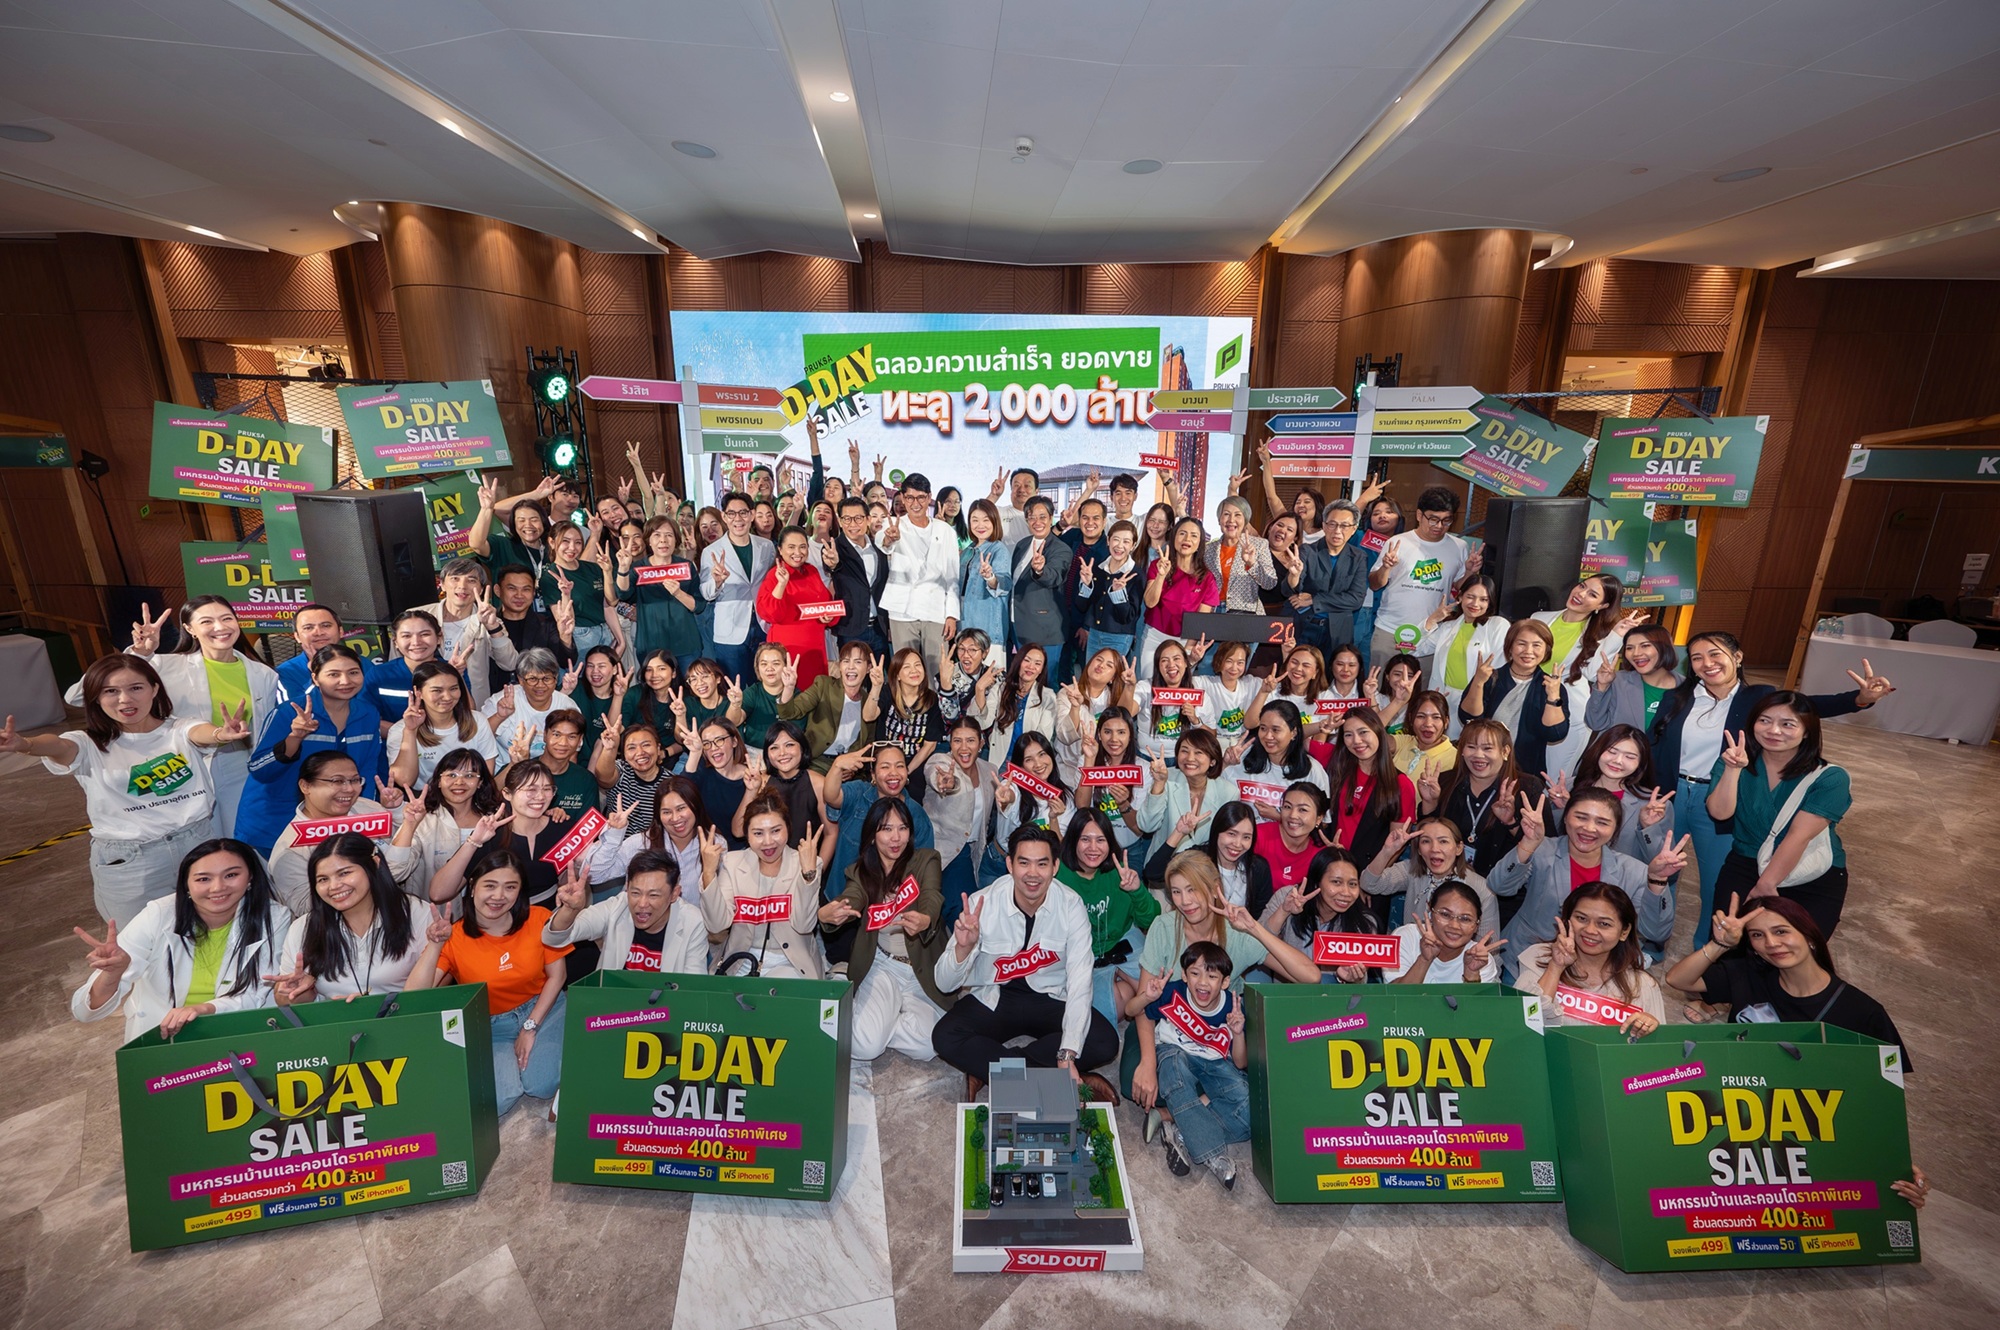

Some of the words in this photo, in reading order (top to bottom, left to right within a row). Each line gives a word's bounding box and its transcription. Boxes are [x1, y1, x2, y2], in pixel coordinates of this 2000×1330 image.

[804, 354, 833, 375] PRUKSA
[876, 345, 1053, 375] ฉลองความสำเร็จ
[1062, 349, 1152, 369] ยอดขาย
[621, 384, 649, 396] รังสิต
[780, 342, 877, 427] D-DAY
[716, 391, 750, 401] พระราม
[753, 392, 759, 401] 2
[1182, 397, 1208, 405] บางนา
[1267, 393, 1320, 406] ประชาอุทิศ
[379, 400, 470, 429] D-DAY
[816, 390, 872, 440] SALE
[882, 387, 953, 434] ทะลุ
[963, 382, 1080, 431] 2,000
[716, 416, 763, 425] เพชรเกษม
[1180, 417, 1204, 429] ชลบุรี
[1285, 420, 1341, 428] บางนา-วงแหวน
[1379, 418, 1413, 426] รามคำแหง
[1415, 417, 1461, 428] กรุงเทพกรีฑา
[237, 430, 265, 439] PRUKSA
[405, 426, 459, 444] SALE
[724, 435, 759, 448] ปิ่นเกล้า
[1481, 419, 1563, 465] D-DAY
[197, 429, 304, 466] D-DAY
[380, 440, 484, 455] มหกรรมบ้านและคอนโดราคาพิเศษ
[1277, 442, 1315, 451] รามอินทรา
[1317, 441, 1344, 451] วัชรพล
[1630, 436, 1732, 459] D-DAY
[434, 449, 453, 459] 400
[1144, 456, 1162, 464] SOLD
[1163, 459, 1177, 467] OUT
[1486, 444, 1533, 473] SALE
[218, 457, 281, 480] SALE
[736, 460, 751, 468] OUT
[1280, 462, 1336, 474] ภูเก็ต-ขอนแก่น
[1645, 460, 1702, 475] SALE
[179, 470, 306, 491] มหกรรมบ้านและคอนโดราคาพิเศษ
[1492, 470, 1509, 483] 400
[1613, 475, 1726, 483] มหกรรมบ้านและคอนโดราคาพิเศษ
[1664, 483, 1686, 491] 400
[643, 569, 666, 579] SOLD
[667, 567, 686, 576] OUT
[1415, 562, 1444, 577] D-DAY
[1422, 571, 1440, 581] SALE
[248, 587, 307, 604] SALE
[805, 605, 824, 615] SOLD
[824, 604, 842, 613] OUT
[1158, 692, 1181, 700] SOLD
[1182, 692, 1200, 701] OUT
[1321, 702, 1345, 710] SOLD
[133, 752, 189, 790] D-DAY
[154, 767, 190, 789] SALE
[1088, 771, 1115, 780] SOLD
[1116, 770, 1138, 779] OUT
[1012, 769, 1035, 787] SOLD
[1035, 784, 1056, 799] OUT
[1242, 786, 1269, 797] SOLD
[305, 825, 349, 839] SOLD
[352, 819, 385, 833] OUT
[554, 836, 582, 862] SOLD
[580, 814, 600, 837] OUT
[740, 904, 766, 917] SOLD
[873, 906, 895, 922] SOL
[1327, 941, 1365, 954] SOLD
[1365, 943, 1393, 956] OUT
[645, 956, 661, 970] OU
[1002, 958, 1030, 975] SOLD
[1030, 950, 1051, 965] OUT
[1556, 991, 1598, 1013] SOLD
[590, 1011, 666, 1029] ครั้งแรกและครั้งเดียว
[683, 1021, 724, 1033] PRUKSA
[1173, 1004, 1205, 1037] SOLD
[1203, 1032, 1228, 1047] OUT
[1291, 1019, 1365, 1039] ครั้งแรกและครั้งเดียว
[1383, 1027, 1425, 1037] PRUKSA
[277, 1056, 329, 1071] PRUKSA
[623, 1031, 788, 1087] D-DAY
[1328, 1038, 1493, 1090] D-DAY
[1627, 1066, 1702, 1090] ครั้งแรกและครั้งเดียว
[1722, 1076, 1767, 1087] PRUKSA
[203, 1057, 409, 1133] D-DAY
[651, 1084, 747, 1123] SALE
[1364, 1092, 1463, 1128] SALE
[1666, 1088, 1844, 1146] D-DAY
[249, 1114, 369, 1162] SALE
[596, 1120, 787, 1142] มหกรรมบ้านและคอนโดราคาพิเศษ
[1312, 1130, 1509, 1148] มหกรรมบ้านและคอนโดราคาพิเศษ
[623, 1142, 683, 1155] ส่วนลดรวมกว่า
[687, 1140, 723, 1159] 400
[1343, 1153, 1405, 1167] ส่วนลดรวมกว่า
[1410, 1147, 1446, 1166] 400
[180, 1140, 420, 1194] มหกรรมบ้านและคอนโดราคาพิเศษ
[658, 1164, 671, 1174] ฟรี
[671, 1167, 698, 1177] ส่วนกลาง
[698, 1167, 705, 1177] 5
[724, 1169, 736, 1179] ฟรี
[1708, 1147, 1813, 1186] SALE
[219, 1183, 296, 1204] ส่วนลดรวมกว่า
[301, 1168, 345, 1190] 400
[1322, 1180, 1348, 1188] จองเพียง
[1384, 1175, 1397, 1186] ฟรี
[1398, 1176, 1425, 1187] ส่วนกลาง
[1425, 1175, 1433, 1186] 5
[1452, 1176, 1465, 1186] ฟรี
[350, 1191, 365, 1201] ฟรี
[1659, 1187, 1861, 1211] มหกรรมบ้านและคอนโดราคาพิเศษ
[269, 1203, 284, 1214] ฟรี
[285, 1201, 318, 1212] ส่วนกลาง
[319, 1196, 327, 1206] 5
[190, 1219, 223, 1229] จองเพียง
[1693, 1215, 1756, 1229] ส่วนลดรวมกว่า
[1761, 1207, 1798, 1228] 400
[1673, 1246, 1700, 1255] จองเพียง
[1737, 1239, 1751, 1251] ฟรี
[1751, 1241, 1780, 1251] ส่วนกลาง
[1779, 1238, 1786, 1250] 5
[1807, 1238, 1820, 1249] ฟรี
[1017, 1253, 1060, 1266] SOLD
[1063, 1255, 1099, 1268] OUT
